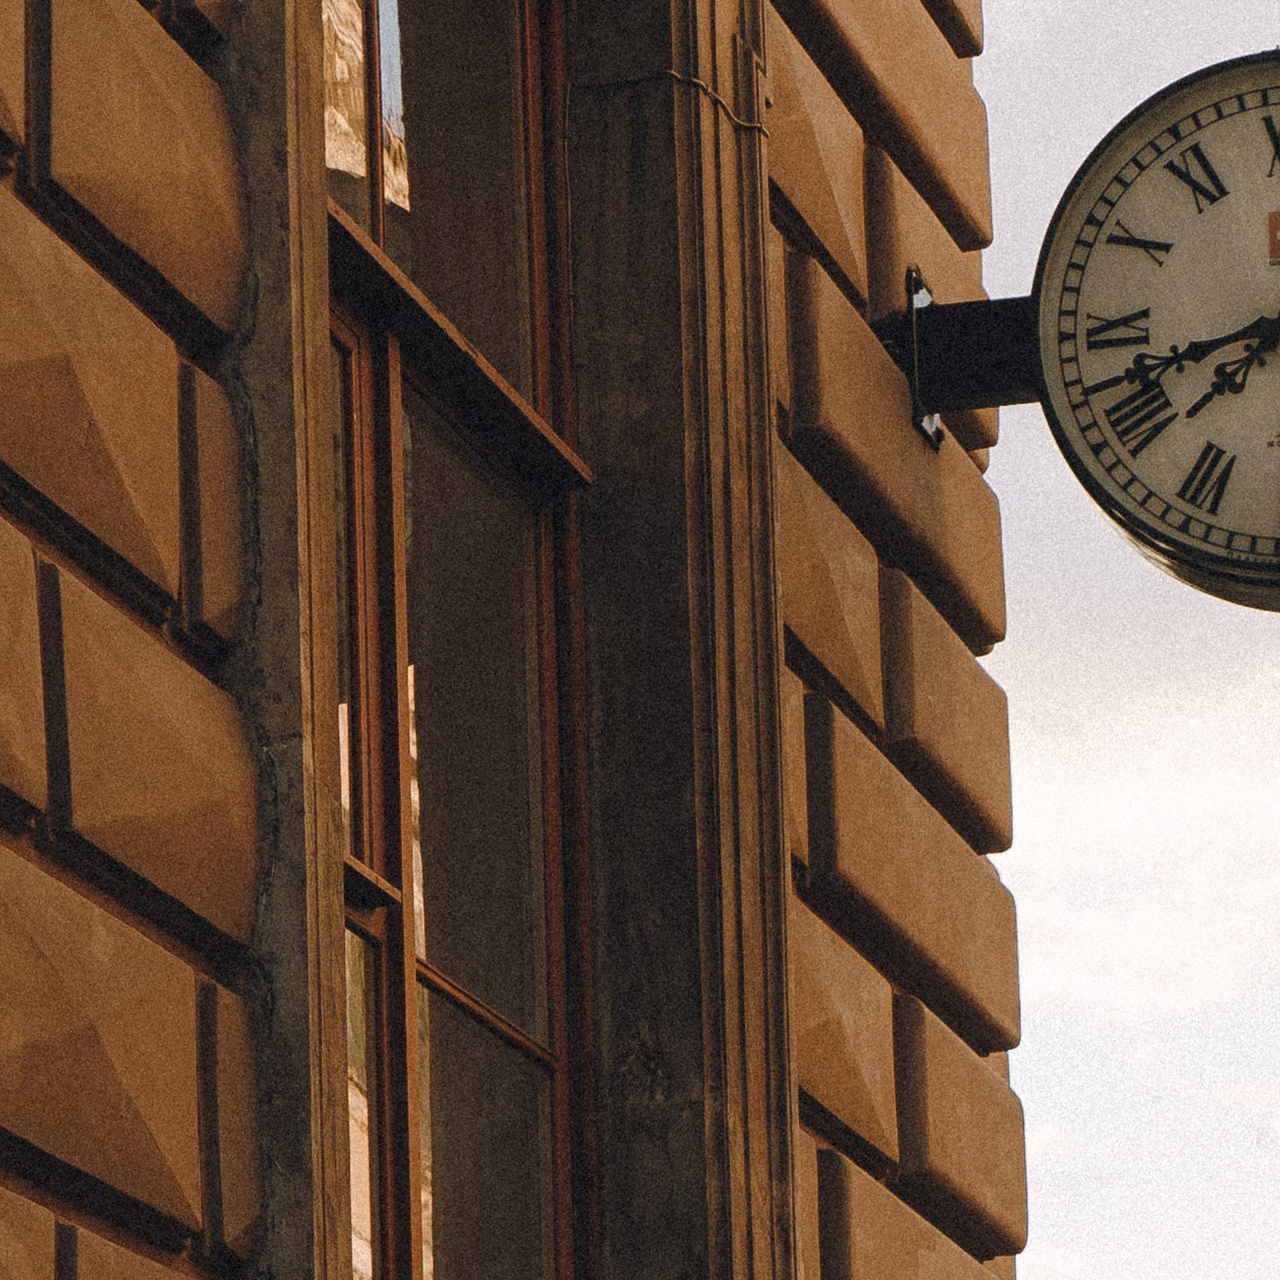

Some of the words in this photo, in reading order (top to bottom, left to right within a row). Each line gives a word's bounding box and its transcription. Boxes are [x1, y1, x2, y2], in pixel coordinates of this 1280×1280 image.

[1164, 142, 1230, 214] XI
[1106, 220, 1174, 267] X
[1086, 307, 1150, 351] IX
[1175, 440, 1237, 516] VII
